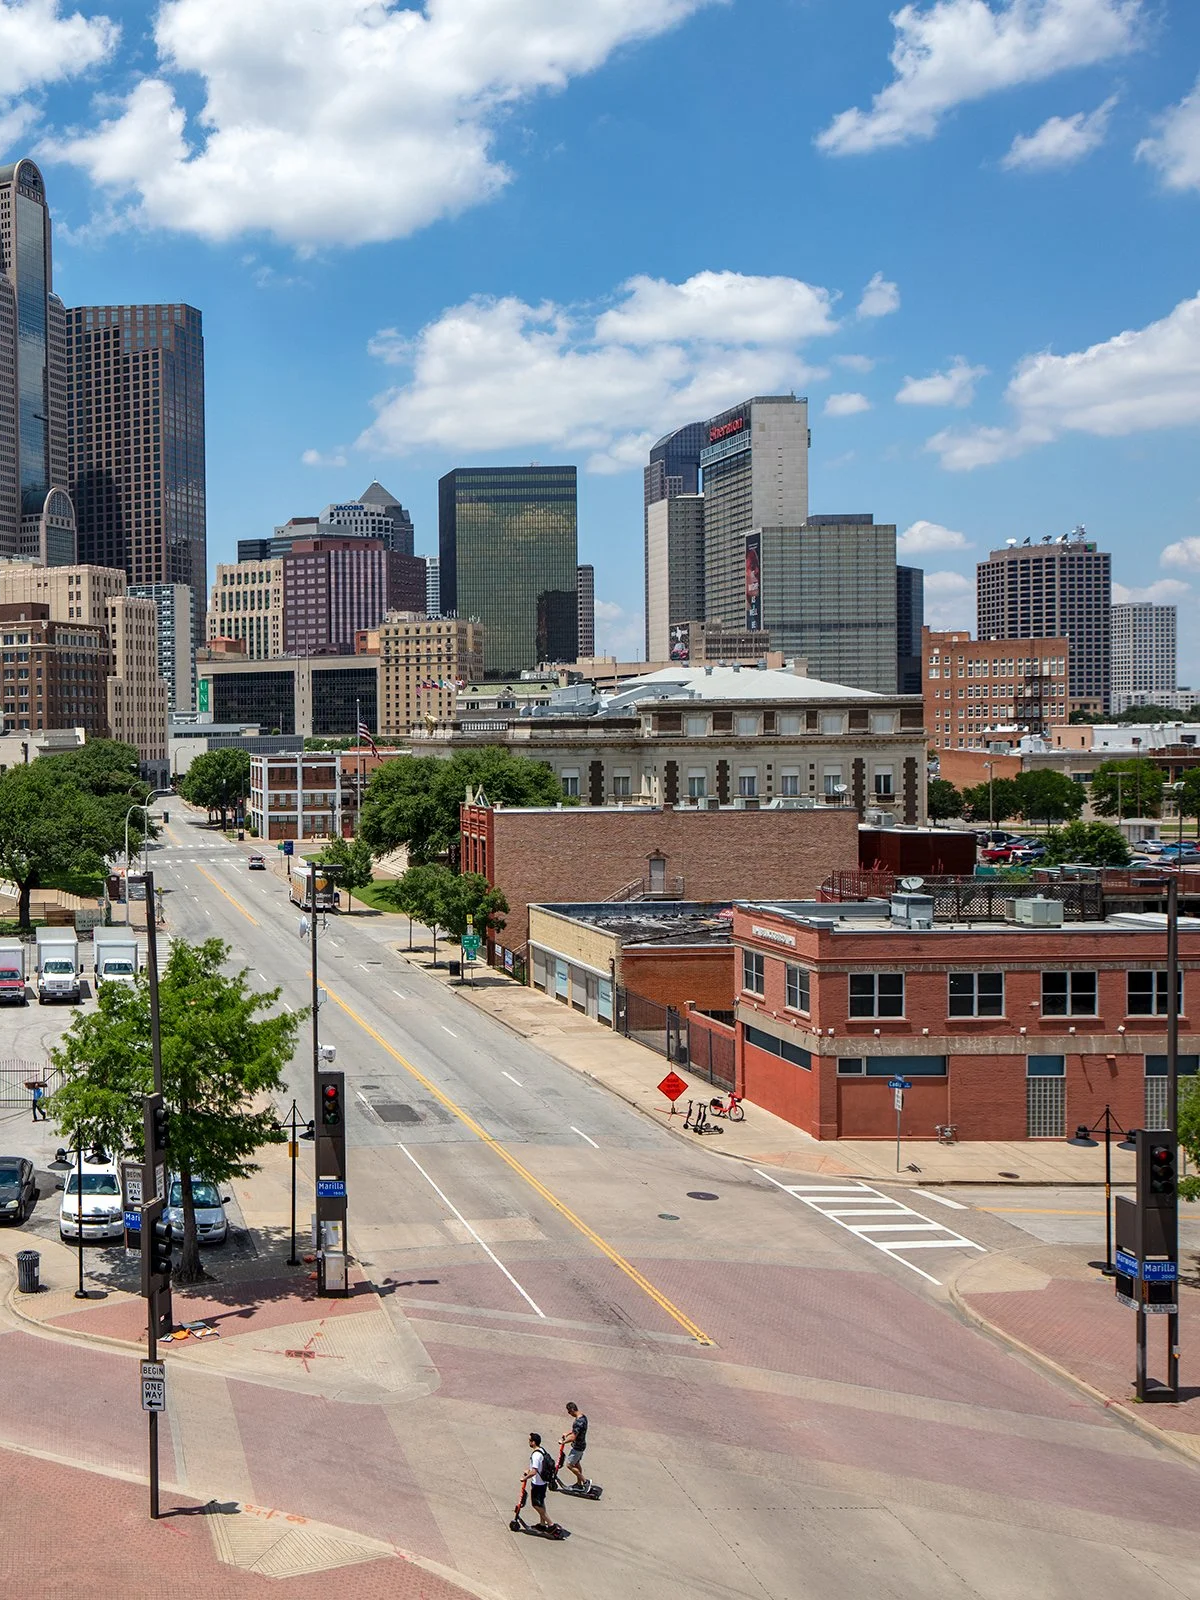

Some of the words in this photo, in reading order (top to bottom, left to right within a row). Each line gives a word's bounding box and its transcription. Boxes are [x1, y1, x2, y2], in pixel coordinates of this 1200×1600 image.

[710, 417, 743, 441] Sheraton
[333, 504, 365, 512] JACOBS
[318, 1182, 344, 1190] Marilla
[125, 1213, 141, 1221] Mari
[1144, 1263, 1176, 1272] Marilla
[142, 1366, 164, 1375] BEGIN
[144, 1382, 163, 1391] ONE
[144, 1391, 163, 1399] WAY
